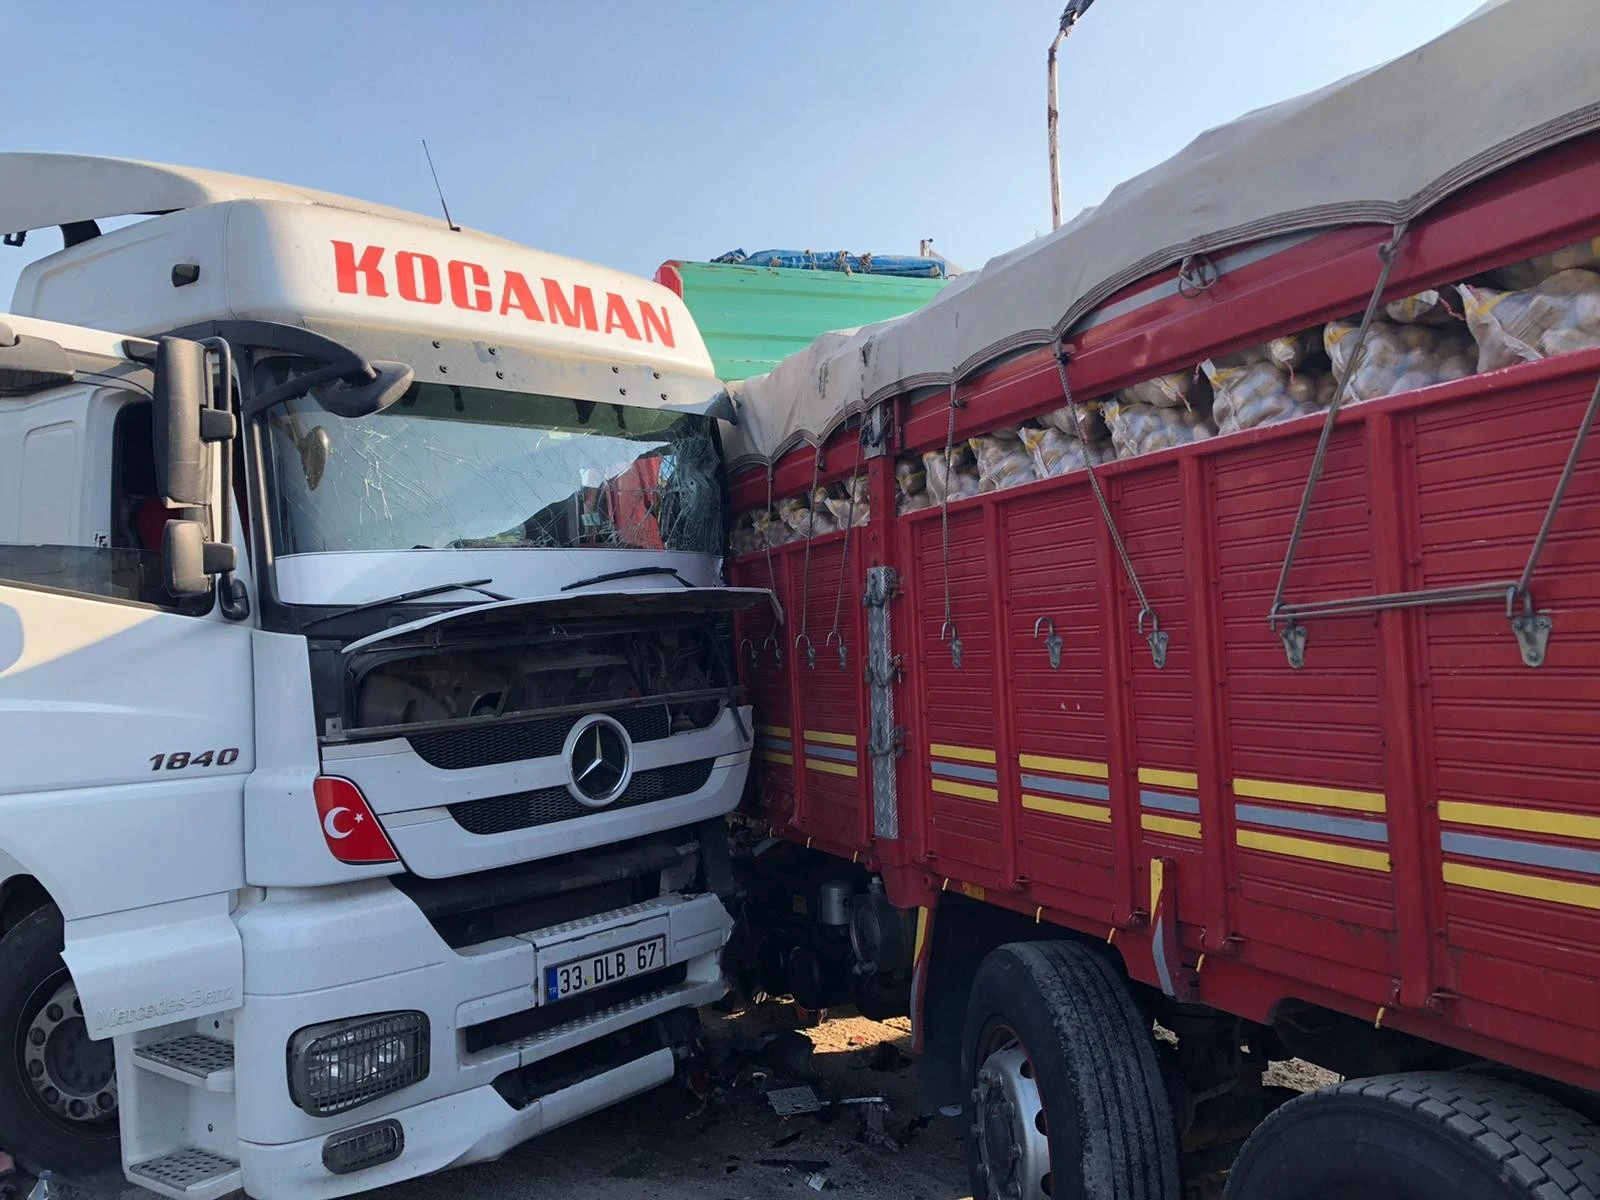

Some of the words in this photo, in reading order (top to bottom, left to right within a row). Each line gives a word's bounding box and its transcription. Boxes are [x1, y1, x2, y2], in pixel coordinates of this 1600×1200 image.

[330, 239, 676, 349] KOCAMAN
[149, 747, 240, 772] 1840
[548, 985, 558, 995] TR
[560, 964, 583, 995] 33
[593, 951, 626, 985] DLB
[637, 941, 657, 970] 67
[95, 984, 235, 1031] Mercedes-Benz
